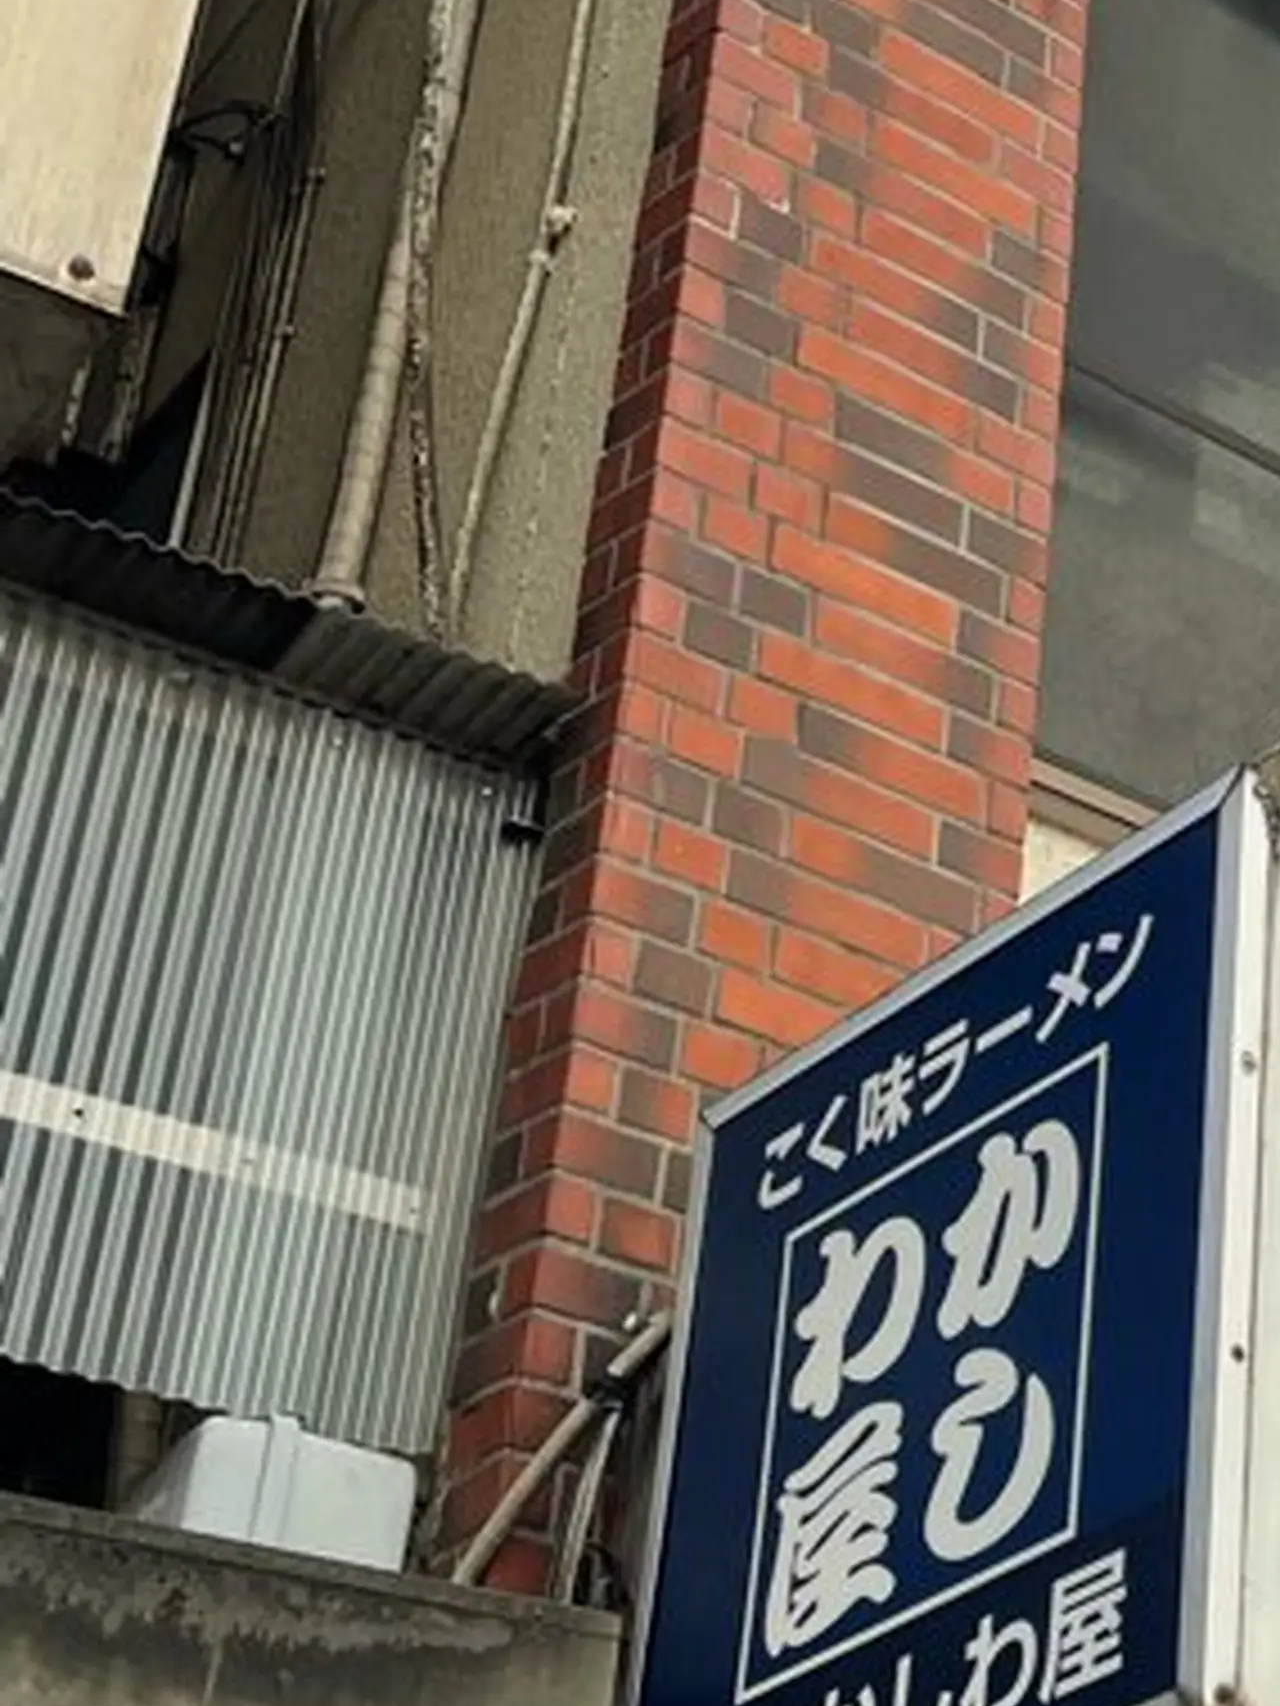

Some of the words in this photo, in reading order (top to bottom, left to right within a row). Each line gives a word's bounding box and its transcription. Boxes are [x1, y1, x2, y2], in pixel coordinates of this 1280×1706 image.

[758, 913, 1154, 1210] こく味ラーメン
